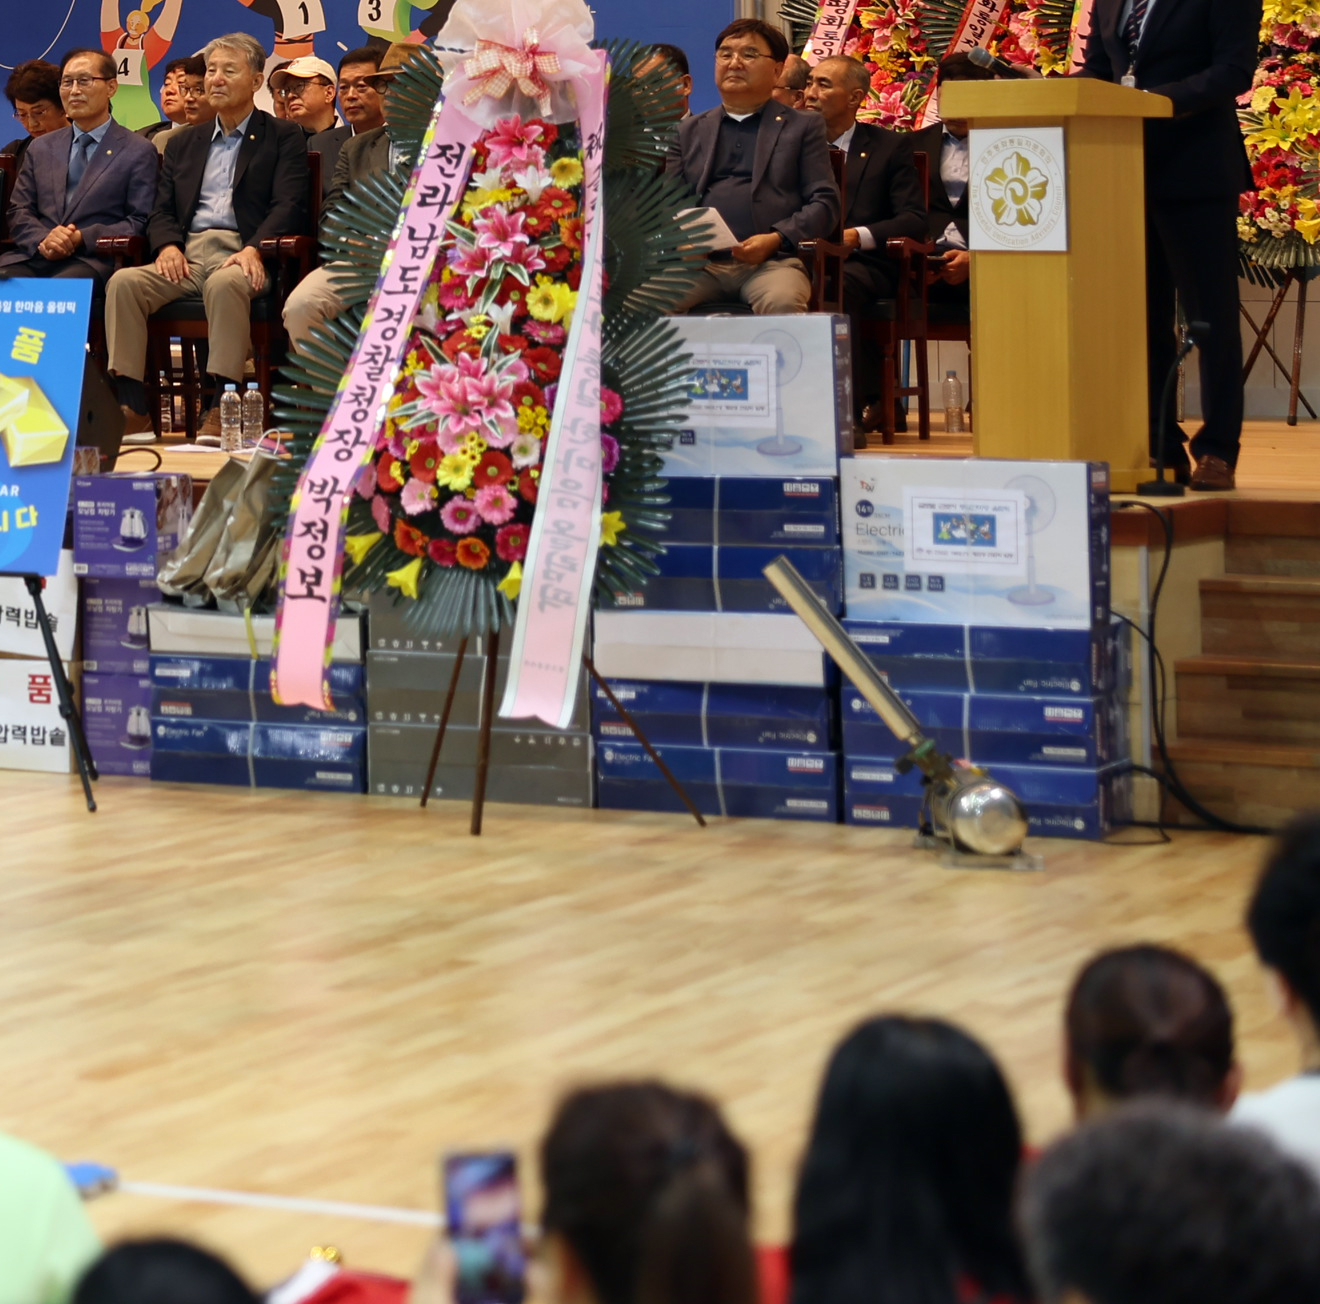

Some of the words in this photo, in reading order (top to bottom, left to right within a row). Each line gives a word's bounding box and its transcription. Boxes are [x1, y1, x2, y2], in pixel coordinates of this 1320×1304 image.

[298, 2, 310, 26] 1
[117, 57, 129, 77] 4
[326, 141, 468, 463] 전라남도경찰청장
[282, 475, 341, 604] 박정보
